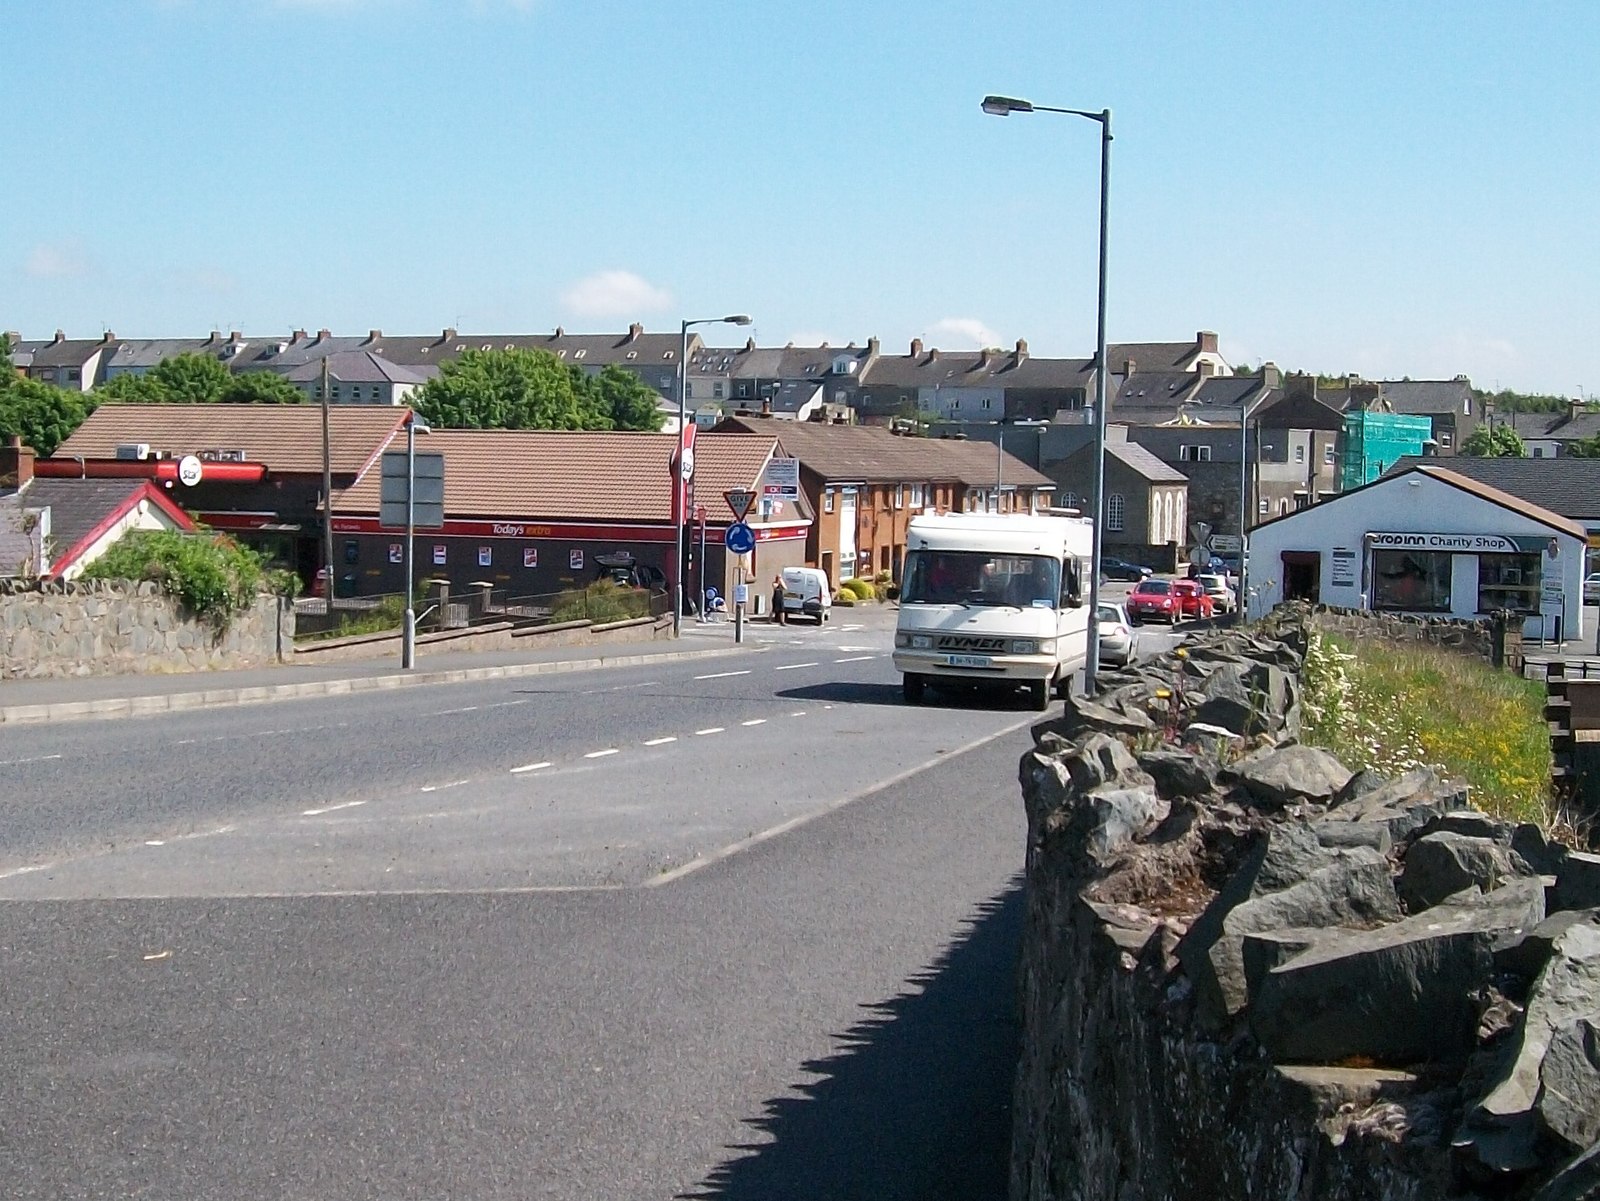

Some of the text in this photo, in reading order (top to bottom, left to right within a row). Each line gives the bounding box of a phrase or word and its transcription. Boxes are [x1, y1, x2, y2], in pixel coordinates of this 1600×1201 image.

[492, 524, 551, 535] Today's extra
[1430, 536, 1472, 549] Charity
[1475, 537, 1506, 549] Shop
[939, 636, 1005, 648] HYMER
